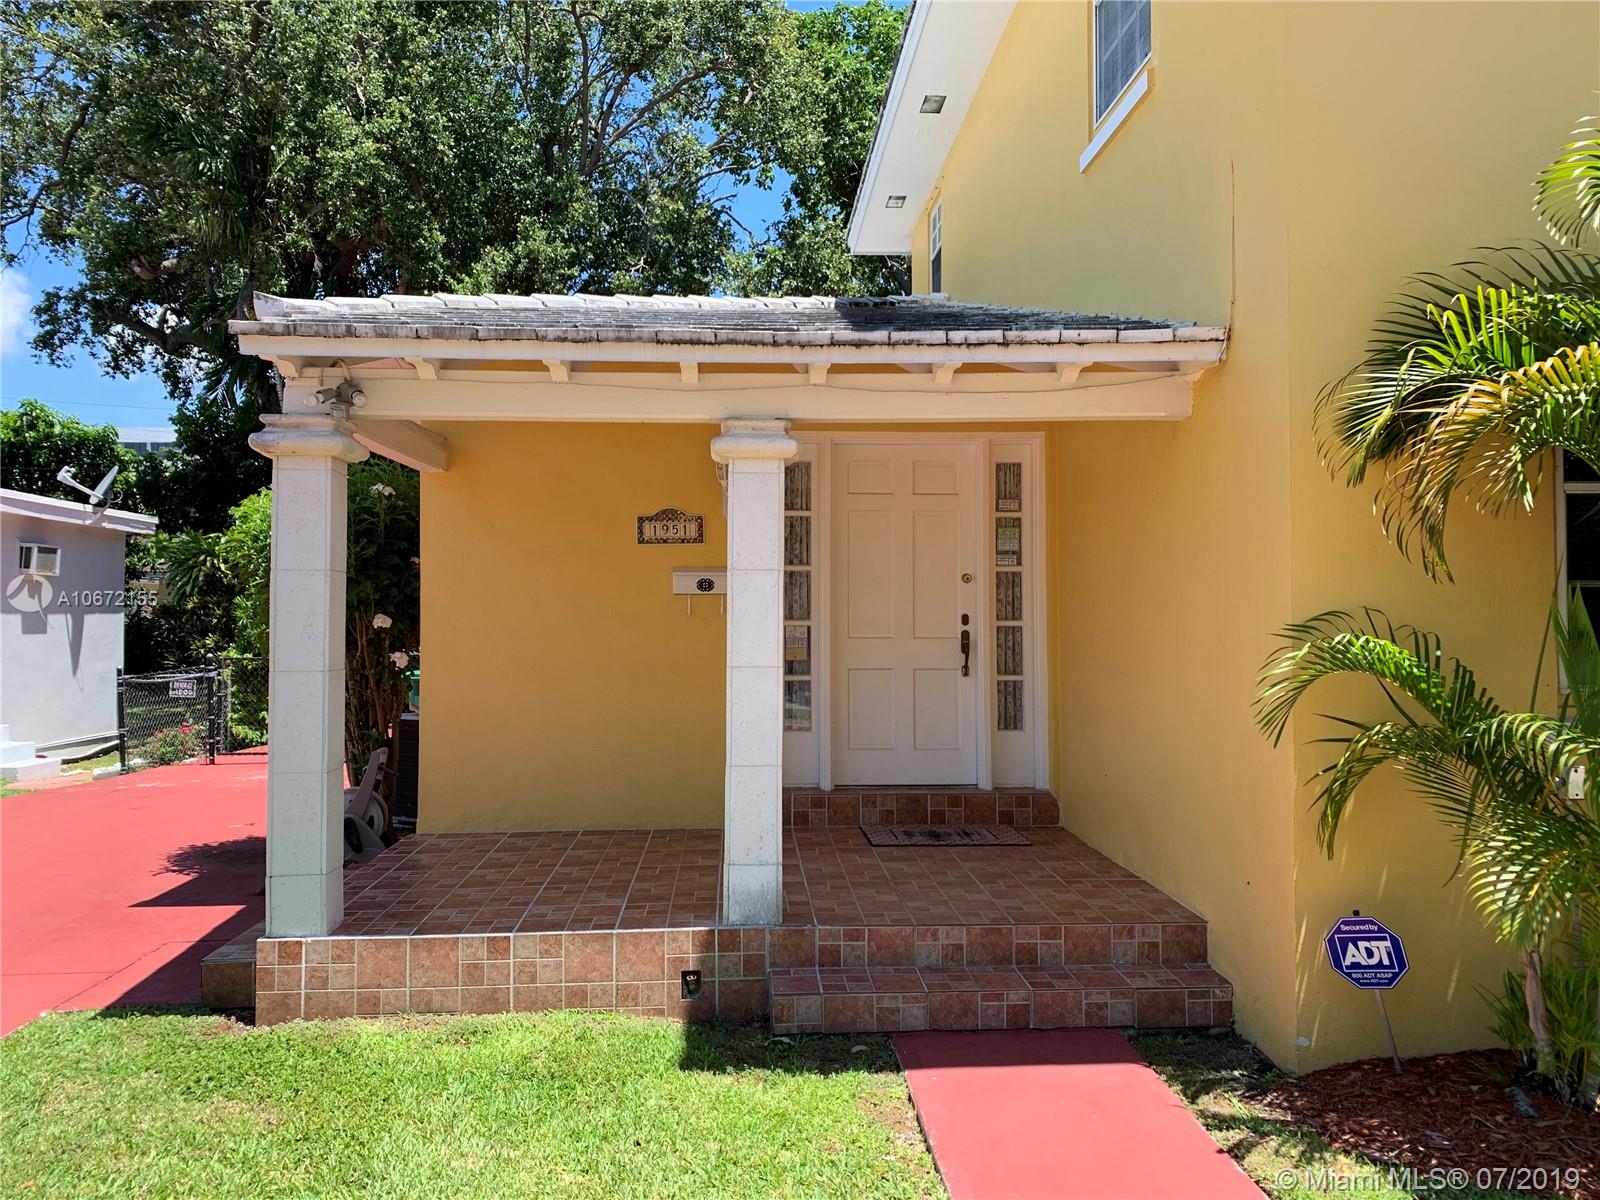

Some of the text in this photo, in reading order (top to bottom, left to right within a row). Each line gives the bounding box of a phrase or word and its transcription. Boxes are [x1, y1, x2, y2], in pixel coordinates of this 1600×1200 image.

[653, 524, 688, 536] 1951
[1369, 924, 1378, 932] by
[1344, 941, 1390, 965] ADT
